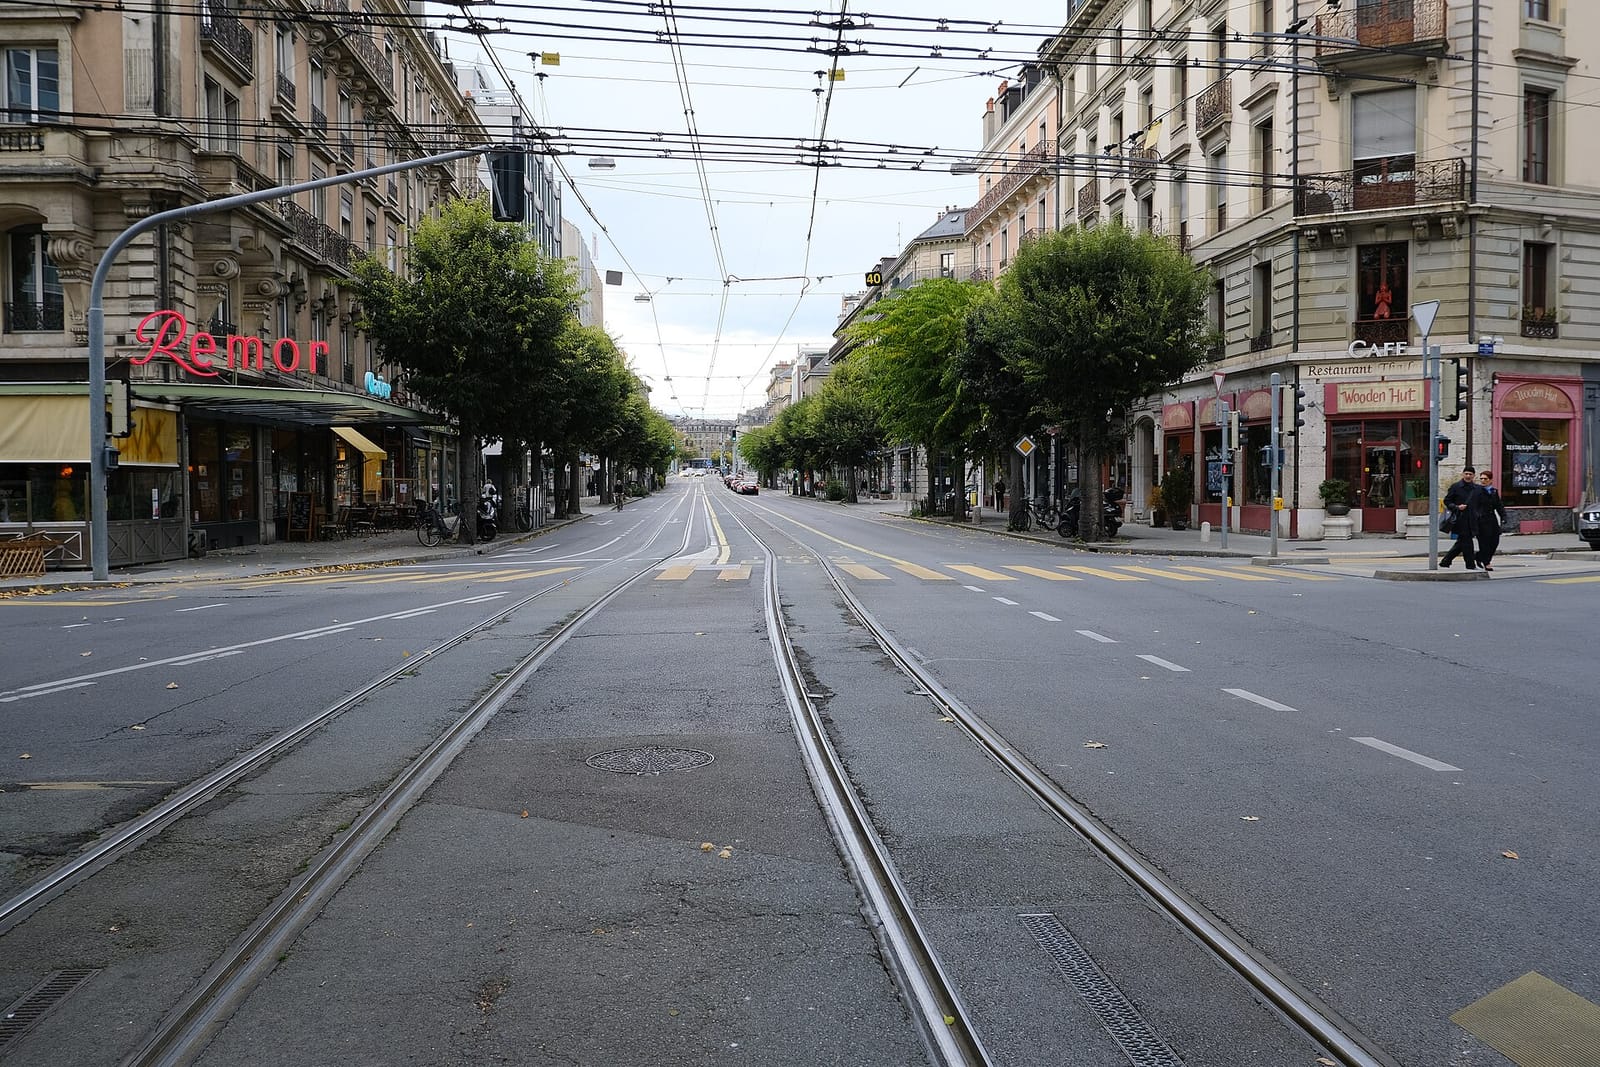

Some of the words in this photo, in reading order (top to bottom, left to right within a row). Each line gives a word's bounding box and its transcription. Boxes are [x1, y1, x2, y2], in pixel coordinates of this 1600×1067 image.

[867, 273, 881, 284] 40
[130, 310, 329, 376] Remor
[1308, 365, 1373, 376] Restaurant
[1340, 388, 1385, 404] Wooden
[1388, 387, 1416, 403] Hut
